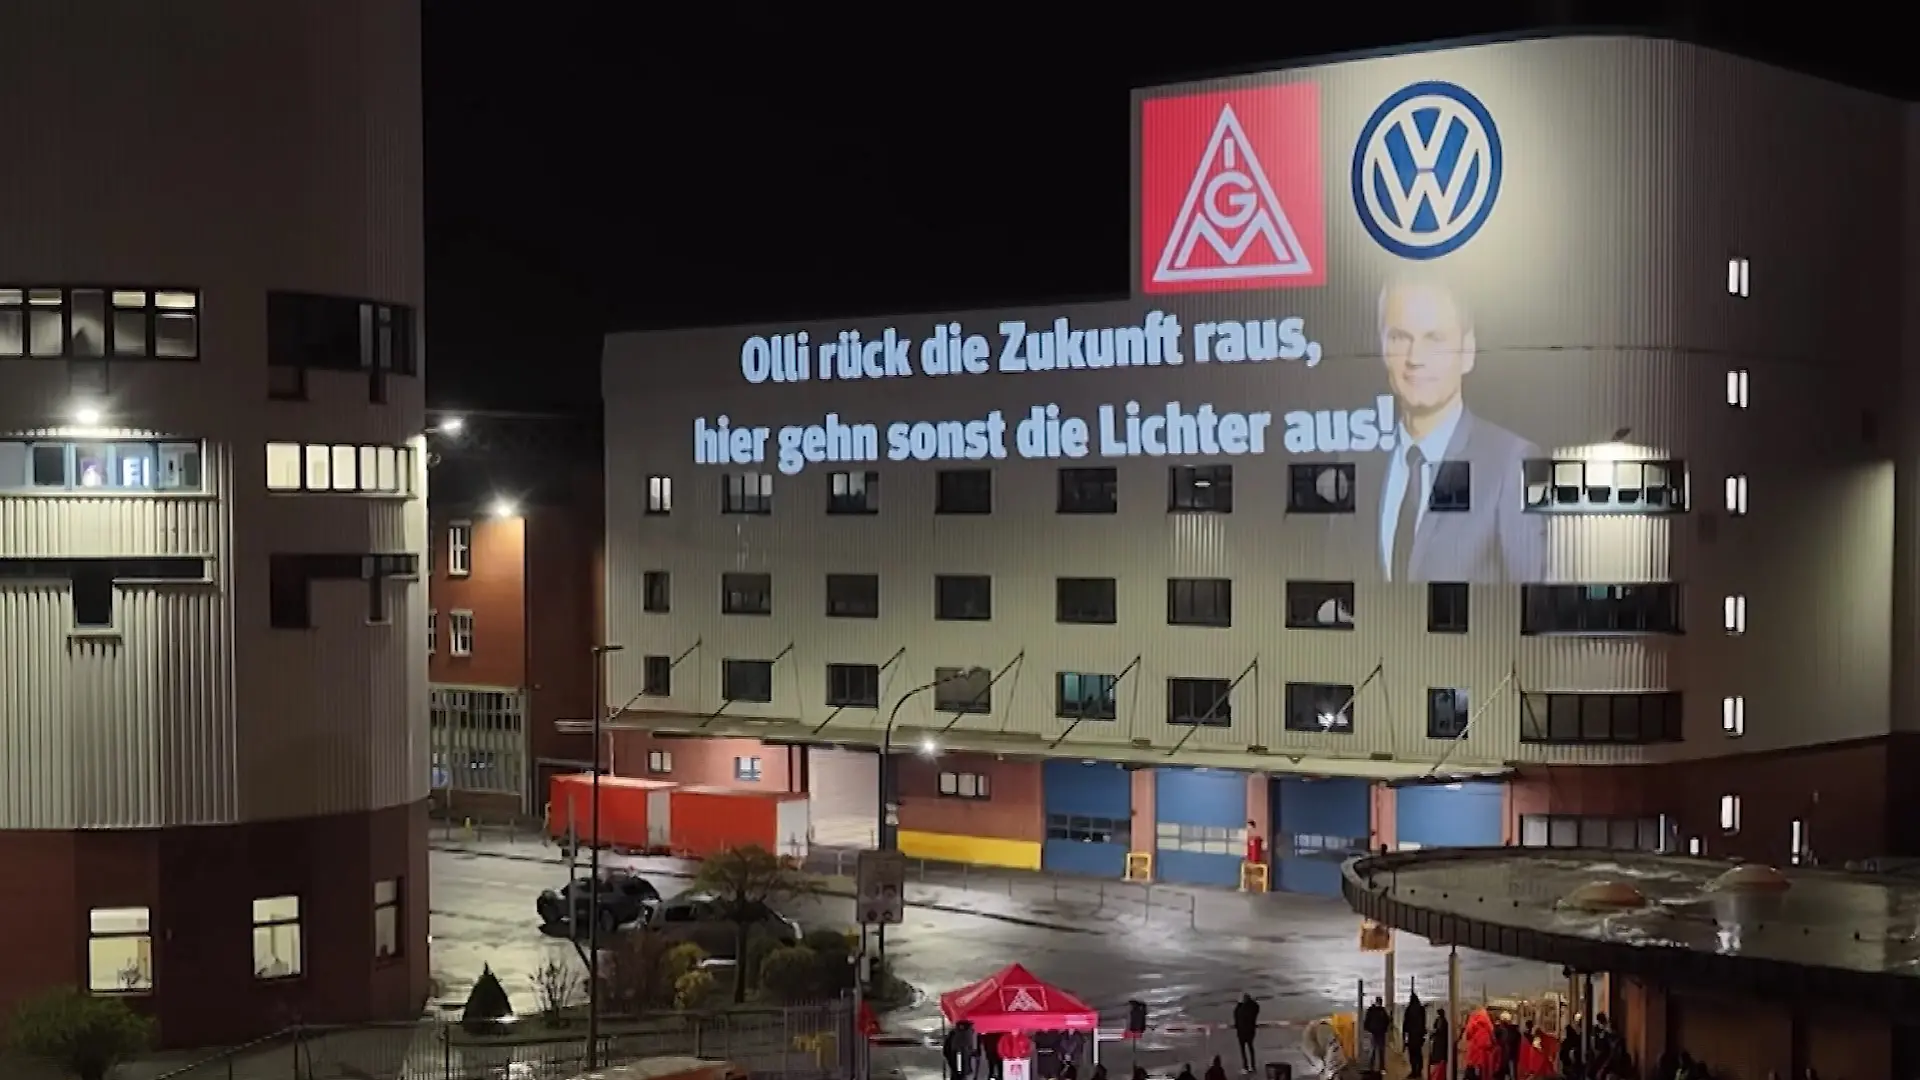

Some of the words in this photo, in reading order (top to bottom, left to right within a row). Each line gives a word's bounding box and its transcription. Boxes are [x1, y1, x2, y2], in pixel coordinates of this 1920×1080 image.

[1360, 91, 1493, 248] VW
[741, 332, 809, 384] Olli
[819, 328, 914, 380] rück
[921, 321, 991, 376] die
[999, 310, 1184, 372] Zukunft
[1193, 316, 1322, 369] raus,
[694, 416, 770, 464] hier
[778, 413, 878, 475] gehn
[887, 410, 1007, 462] sonst
[1016, 402, 1089, 459] die
[1099, 400, 1272, 457] Lichter
[1283, 394, 1396, 454] aus!
